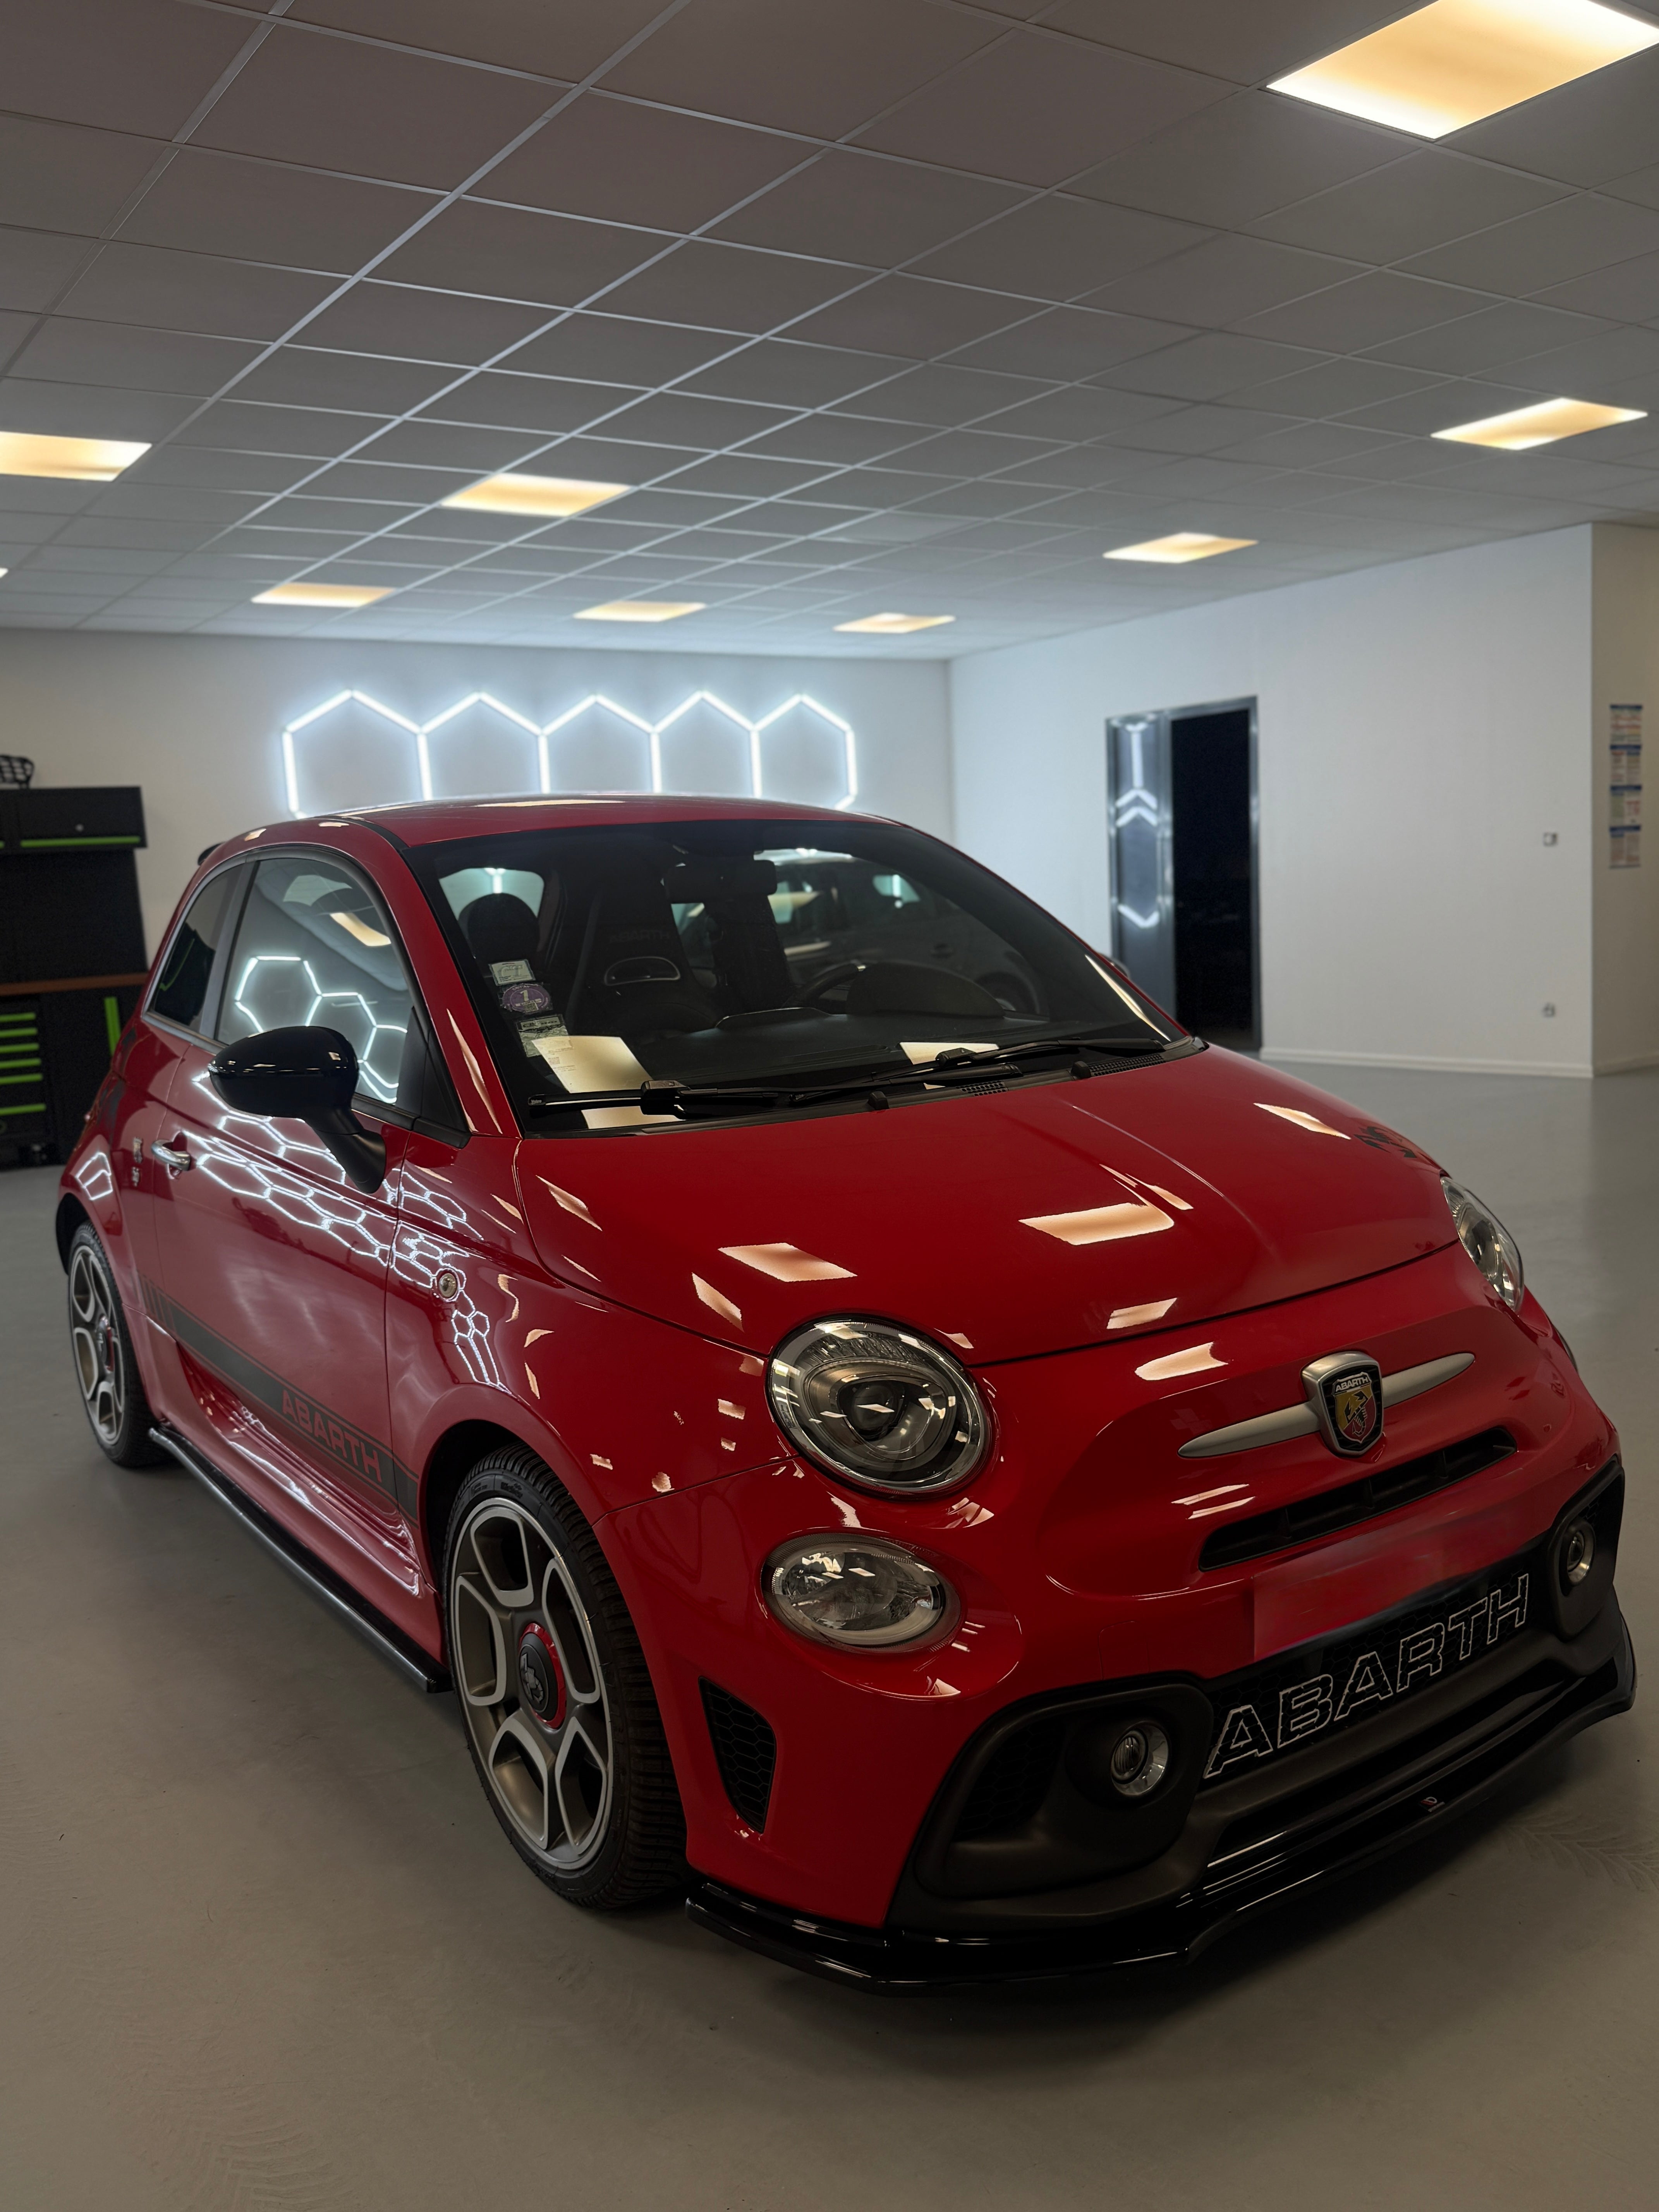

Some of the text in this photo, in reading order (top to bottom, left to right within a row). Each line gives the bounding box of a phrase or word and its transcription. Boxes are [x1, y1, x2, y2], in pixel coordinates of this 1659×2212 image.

[519, 989, 529, 1001] 1
[1335, 1376, 1369, 1393] ABARTH
[282, 1389, 382, 1483] ABARTH
[1203, 1573, 1529, 1779] ABARTH
